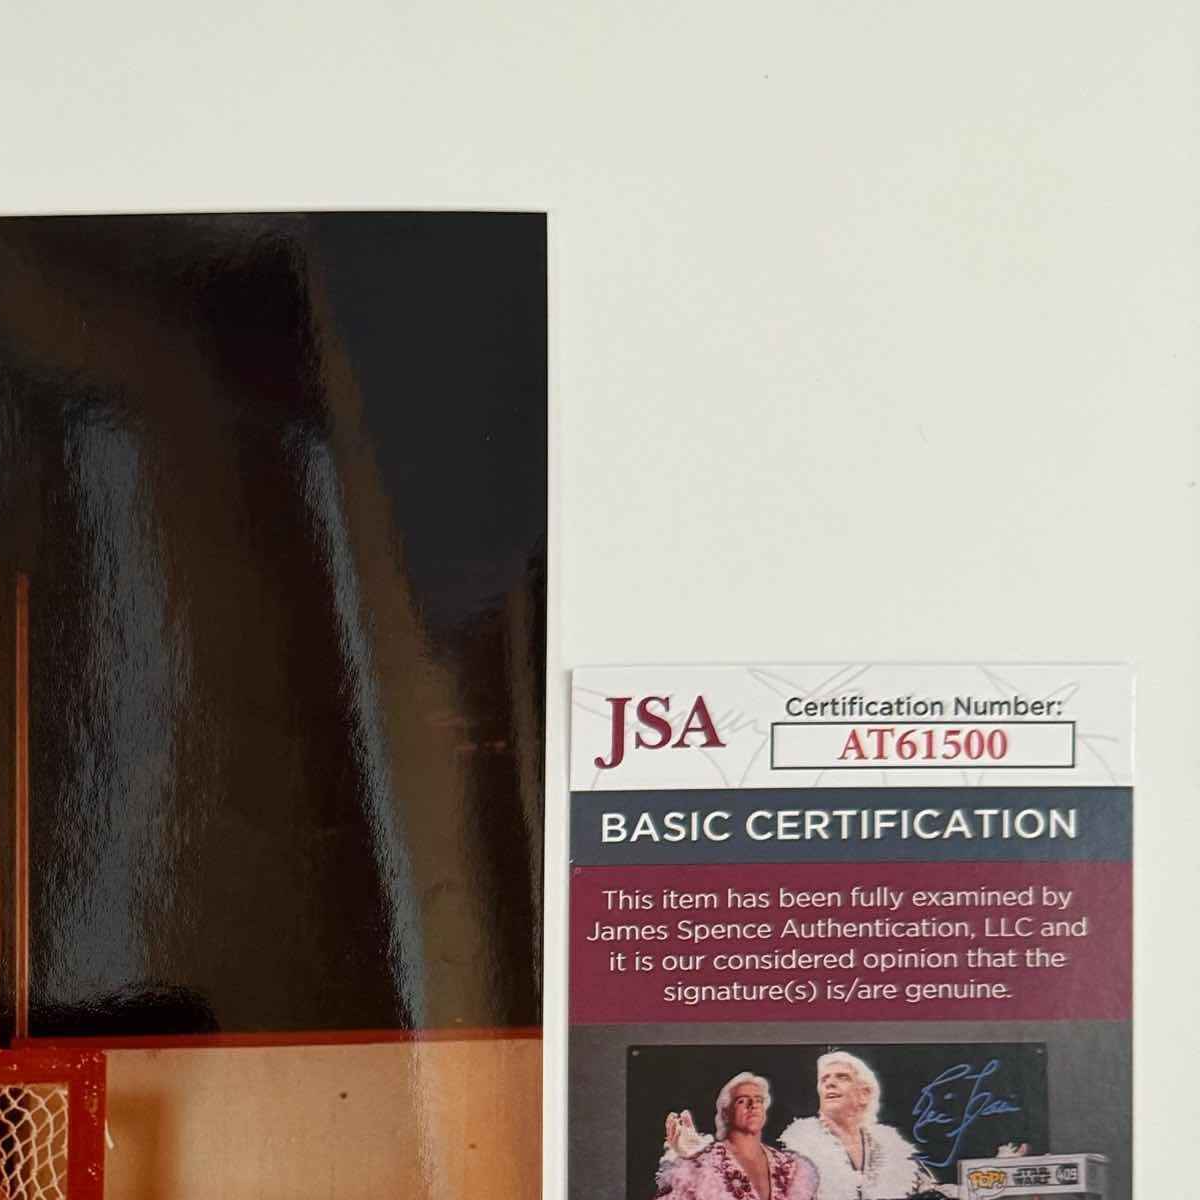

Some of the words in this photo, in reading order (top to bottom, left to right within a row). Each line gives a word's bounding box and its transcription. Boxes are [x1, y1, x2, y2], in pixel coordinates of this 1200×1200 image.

[785, 697, 944, 717] Certification
[953, 697, 1063, 716] Number:
[595, 695, 726, 769] JSA
[838, 728, 1008, 761] AT61500
[601, 811, 732, 843] BASIC
[745, 808, 1077, 840] CERTIFICATION
[602, 890, 653, 910] This
[662, 889, 717, 910] item
[727, 889, 769, 909] has
[779, 888, 841, 908] been
[850, 887, 903, 911] fully
[912, 886, 1033, 907] examined
[1041, 886, 1072, 910] by
[587, 921, 667, 941] James
[677, 920, 771, 942] Spence
[780, 918, 976, 940] Authentication,
[985, 917, 1033, 937] LLC
[1040, 916, 1087, 937] and
[609, 951, 626, 972] it
[635, 951, 653, 972] is
[662, 952, 703, 971] our
[713, 949, 854, 970] considered
[863, 949, 958, 970] opinion
[967, 948, 1018, 968] that
[1027, 948, 1065, 968] the
[663, 980, 816, 1006] signature(s)
[826, 979, 897, 1003] is/are
[905, 981, 1012, 1004] genuine.
